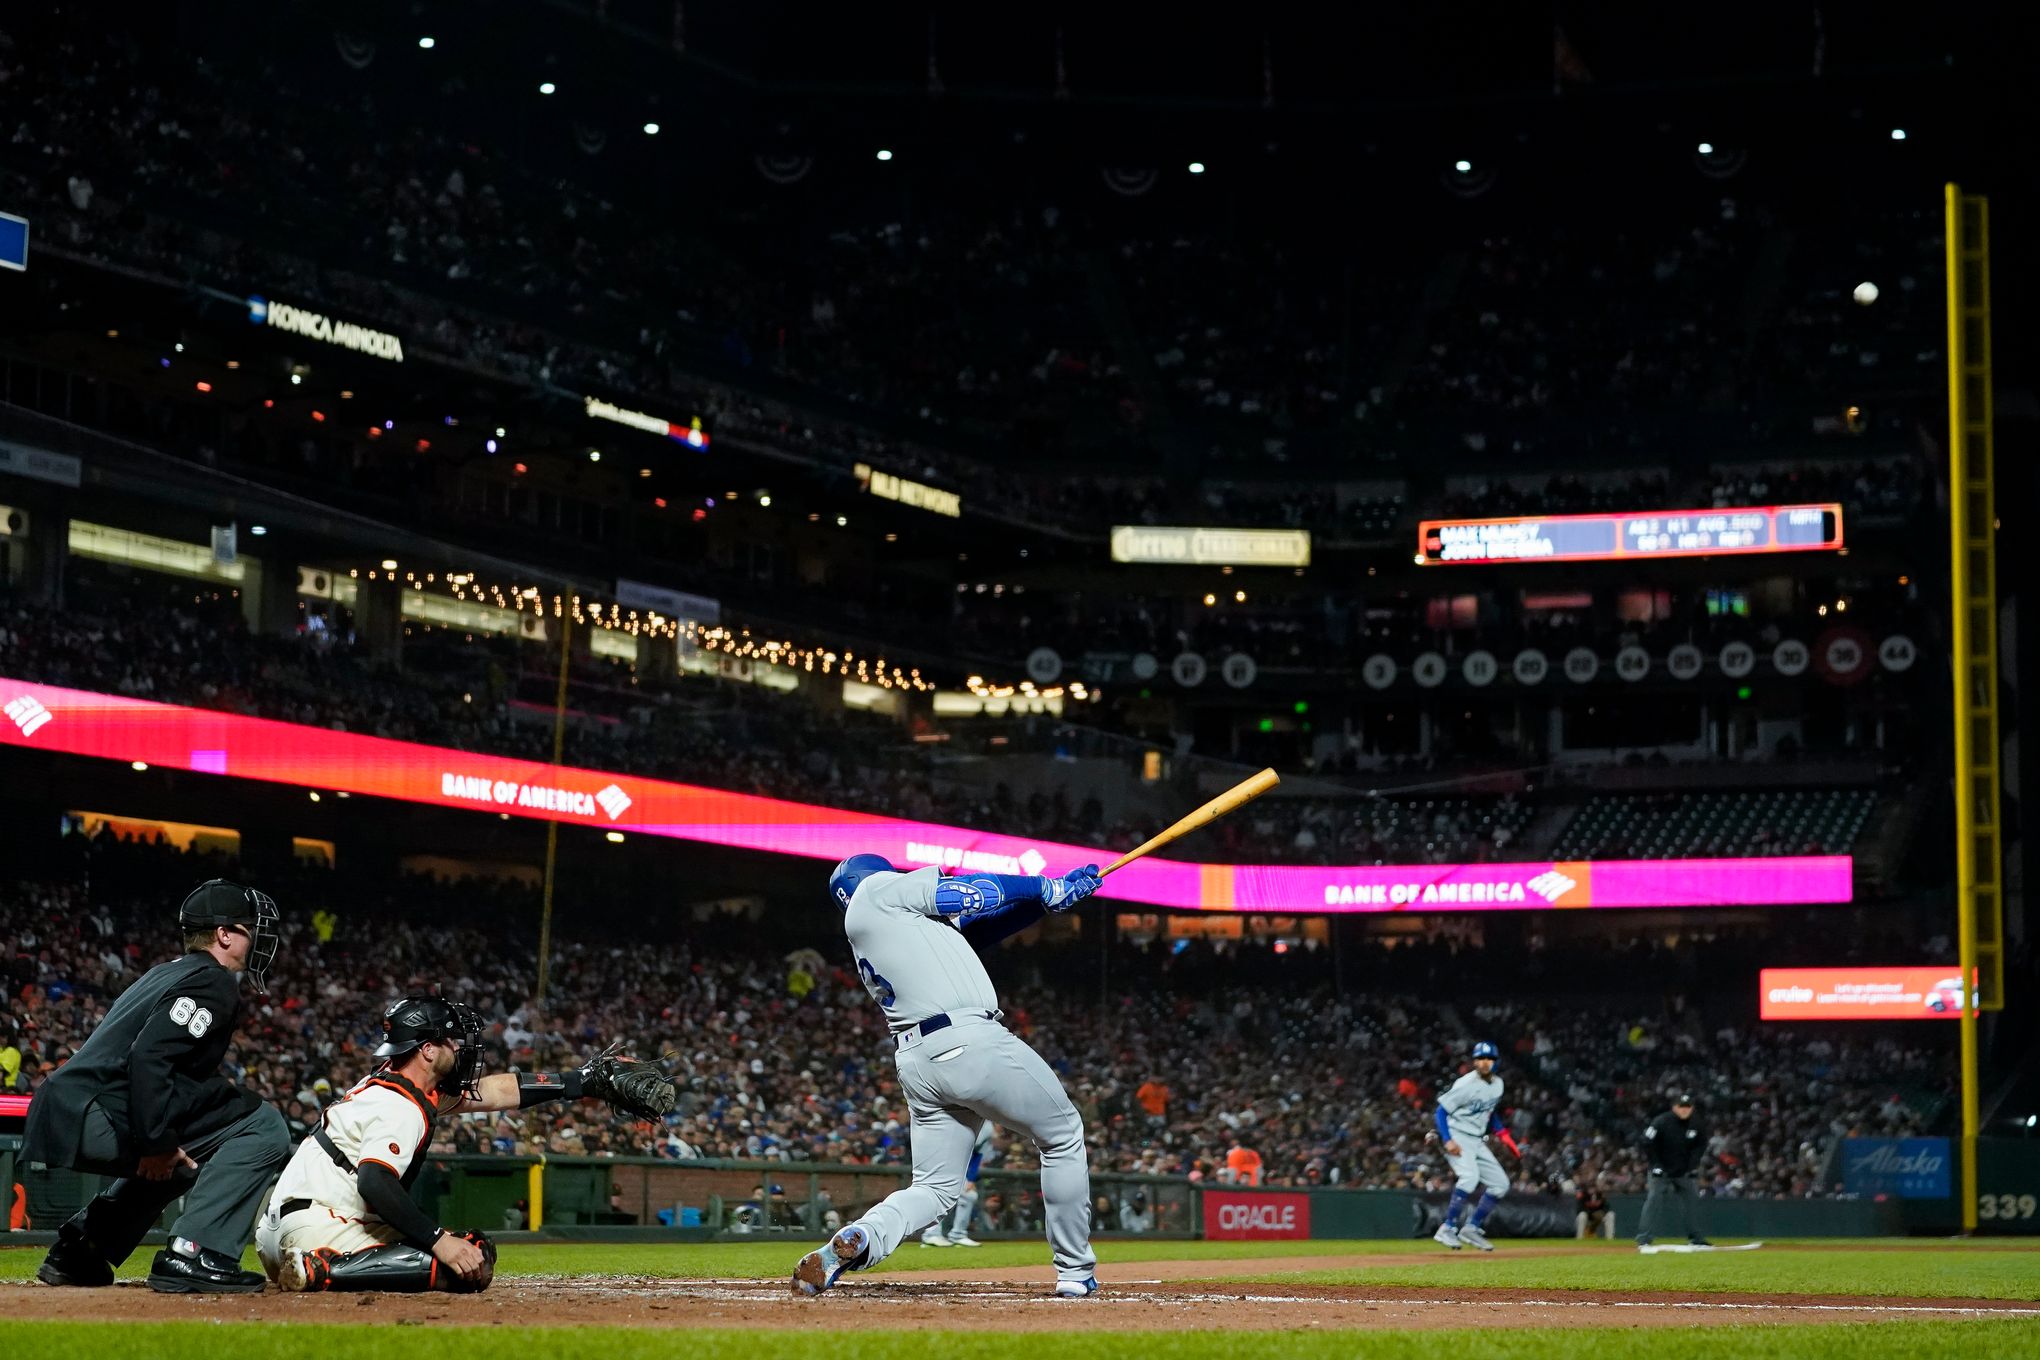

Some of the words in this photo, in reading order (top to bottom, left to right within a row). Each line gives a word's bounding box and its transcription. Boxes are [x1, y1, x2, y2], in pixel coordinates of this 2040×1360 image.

[268, 301, 333, 342] KONICA
[333, 320, 403, 362] MINOLTA
[442, 772, 493, 801] BANK
[493, 780, 518, 805] OF
[518, 784, 595, 816] AMERICA
[906, 841, 945, 865] BANK
[944, 847, 964, 868] OF
[961, 850, 1020, 875] AMERICA
[1324, 885, 1387, 904] BANK
[1389, 884, 1420, 903] OF
[1422, 883, 1525, 904] AMERICA
[169, 996, 213, 1039] 66
[1848, 1144, 1943, 1175] Alaska
[1218, 1204, 1296, 1230] ORACLE
[1978, 1193, 2038, 1220] 339
